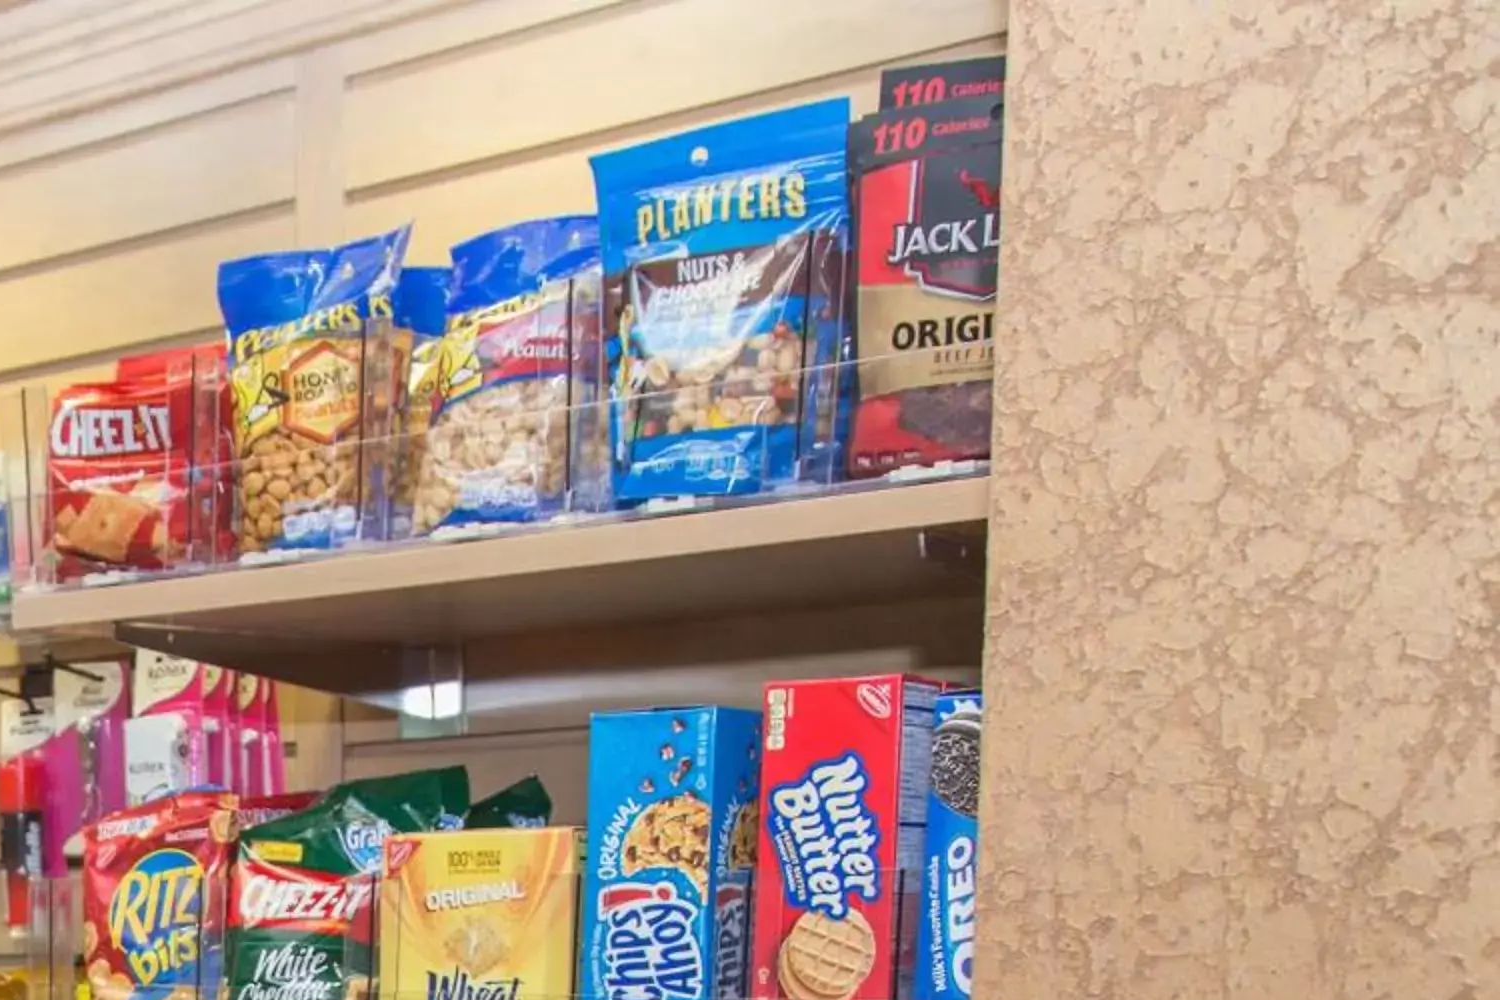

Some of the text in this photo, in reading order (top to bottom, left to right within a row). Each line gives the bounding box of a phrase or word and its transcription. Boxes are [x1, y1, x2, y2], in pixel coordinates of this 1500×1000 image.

[892, 76, 946, 109] 110
[873, 117, 927, 155] 110
[636, 172, 807, 247] PLANTERS
[888, 218, 979, 264] JACK
[677, 254, 729, 282] NUTS
[598, 797, 642, 880] ORIGINAL
[773, 779, 844, 916] Butter
[811, 755, 877, 898] Nutter
[112, 864, 202, 949] RITZ
[239, 875, 370, 922] CHEEZ-IT
[426, 882, 526, 911] ORIGINAL
[947, 835, 976, 996] OREO
[929, 899, 943, 952] Favorite
[129, 929, 198, 987] bits
[253, 940, 330, 986] White
